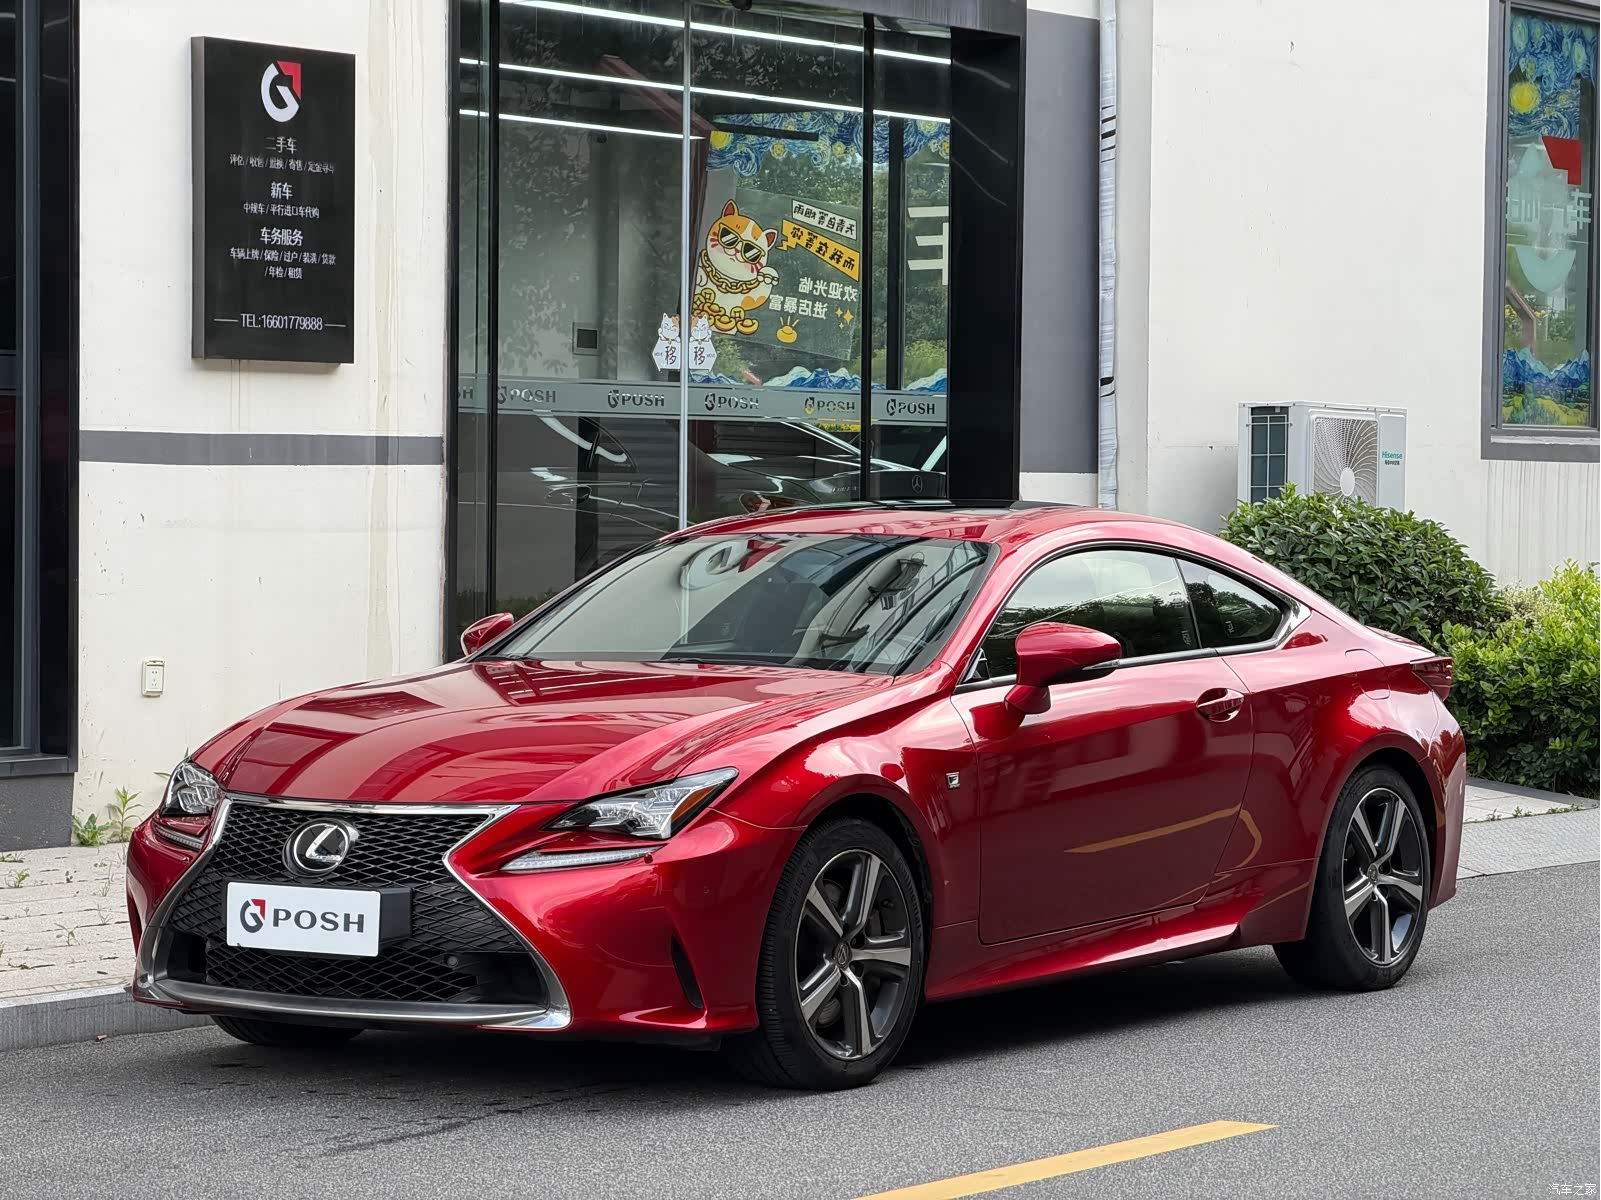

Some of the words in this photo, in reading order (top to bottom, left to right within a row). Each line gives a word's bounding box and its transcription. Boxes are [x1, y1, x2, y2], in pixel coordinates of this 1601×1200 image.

[264, 136, 298, 155] 二手车
[270, 181, 293, 200] 新车
[260, 226, 304, 246] 车务服务
[240, 313, 323, 331] TEL:16601779888
[664, 345, 677, 366] 移
[693, 346, 706, 366] 移
[510, 388, 556, 403] POSH
[622, 393, 665, 407] POSH
[718, 396, 759, 410] POSH
[817, 400, 855, 413] POSH
[899, 402, 935, 415] POSH
[1381, 450, 1403, 460] Hisense
[272, 907, 365, 933] POSH
